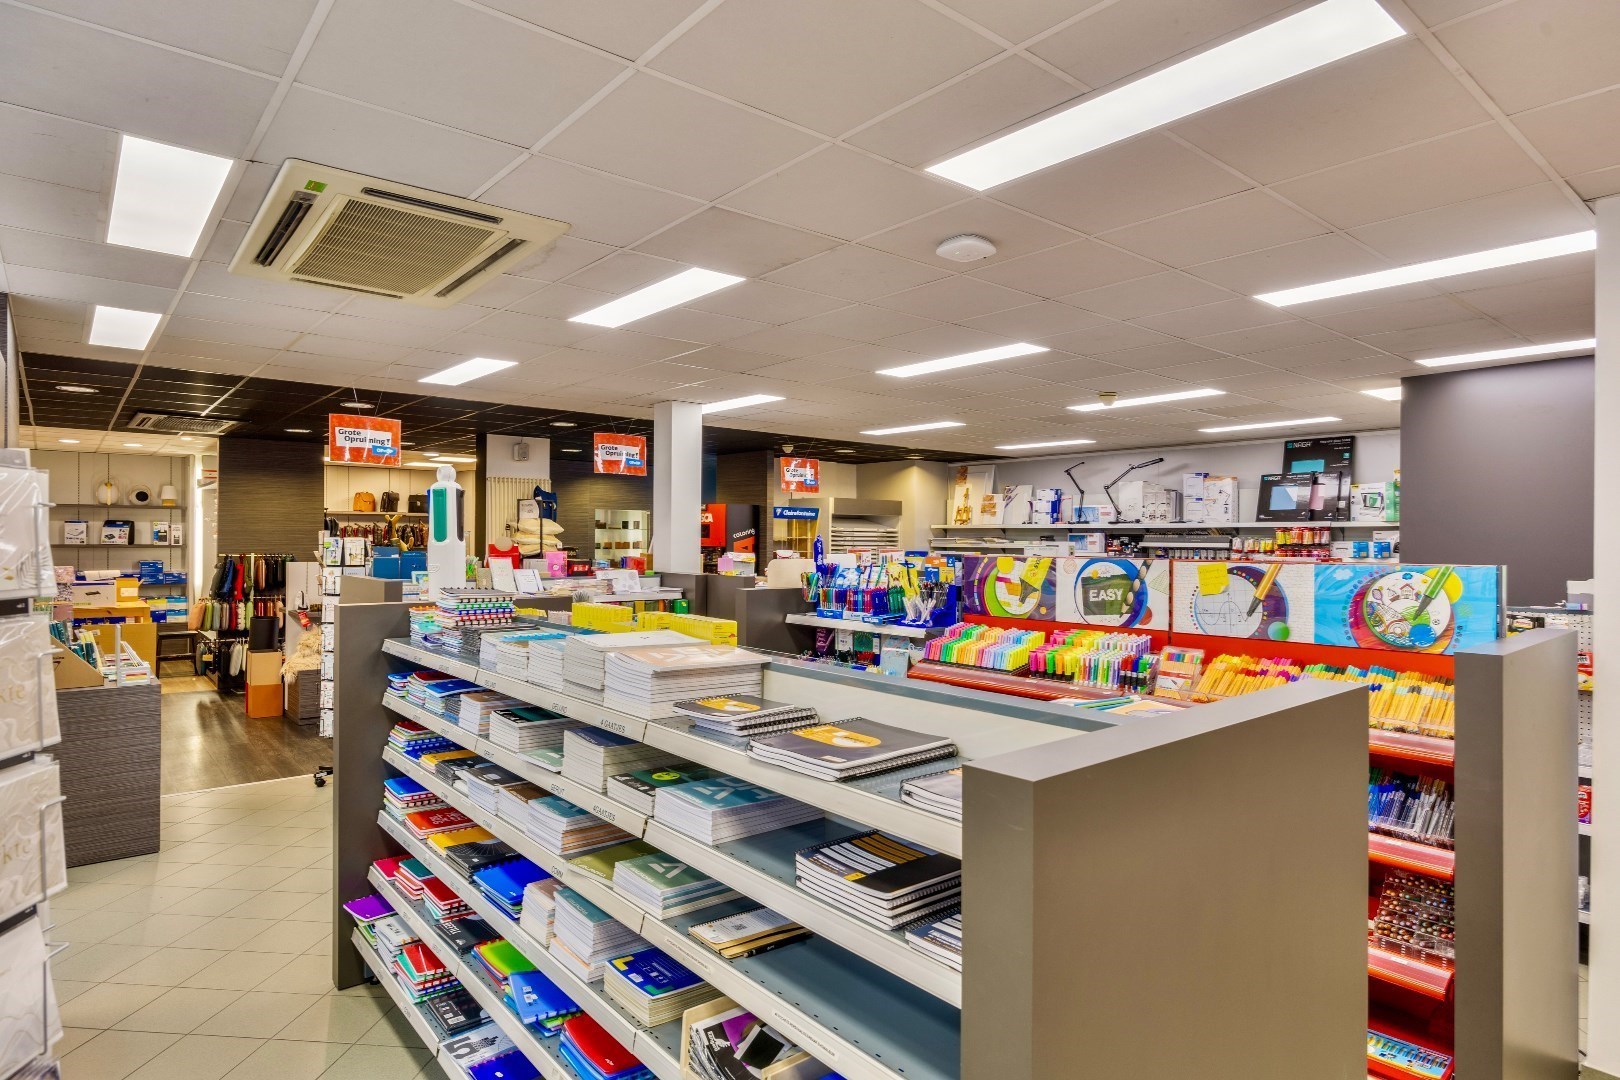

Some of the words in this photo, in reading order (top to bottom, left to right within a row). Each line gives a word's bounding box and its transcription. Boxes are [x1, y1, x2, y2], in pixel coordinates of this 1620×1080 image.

[338, 428, 361, 436] Grote
[783, 509, 816, 517] Clairefontaine
[1089, 588, 1124, 601] EASY
[604, 719, 626, 734] GAATJES
